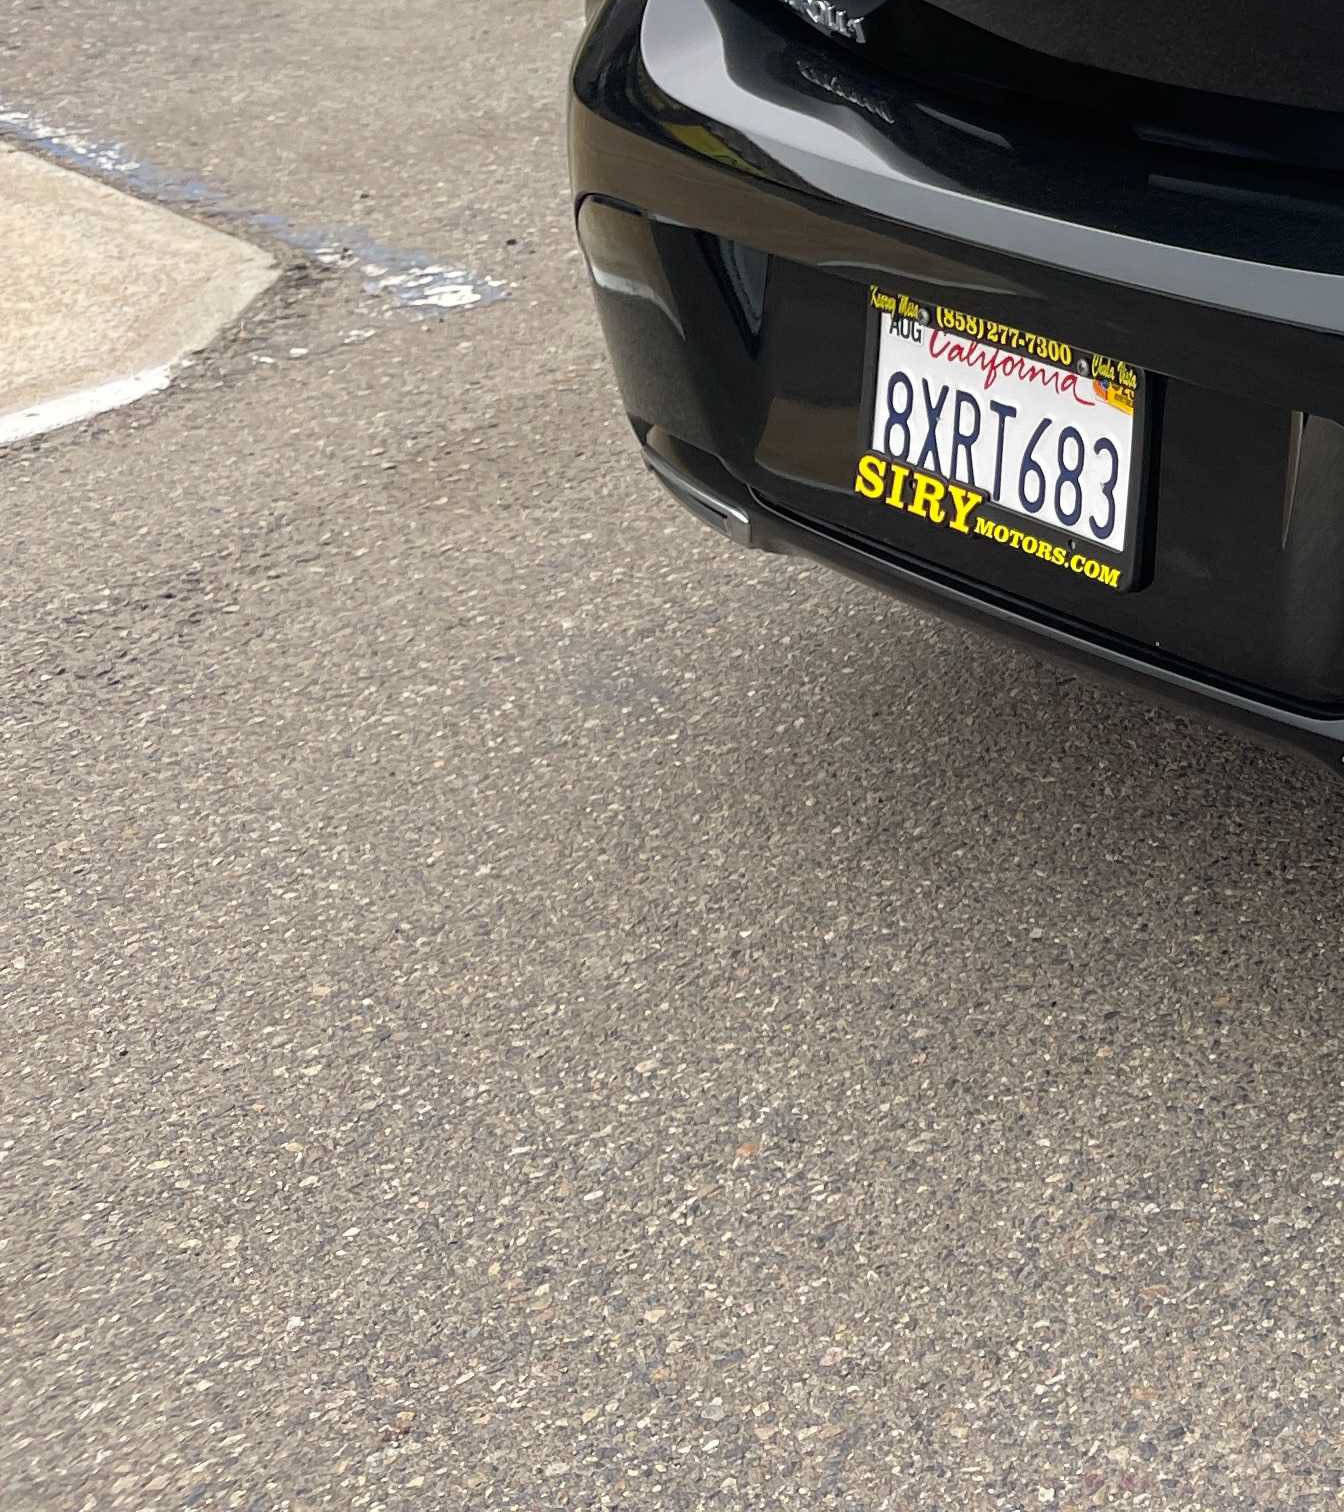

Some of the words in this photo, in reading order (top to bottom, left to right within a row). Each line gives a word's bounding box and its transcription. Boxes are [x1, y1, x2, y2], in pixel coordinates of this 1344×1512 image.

[889, 317, 922, 344] AUG
[928, 329, 1096, 406] California
[883, 370, 1120, 541] 8XRT683
[855, 454, 984, 535] SIRY
[974, 515, 1121, 589] MOTORS.COM
